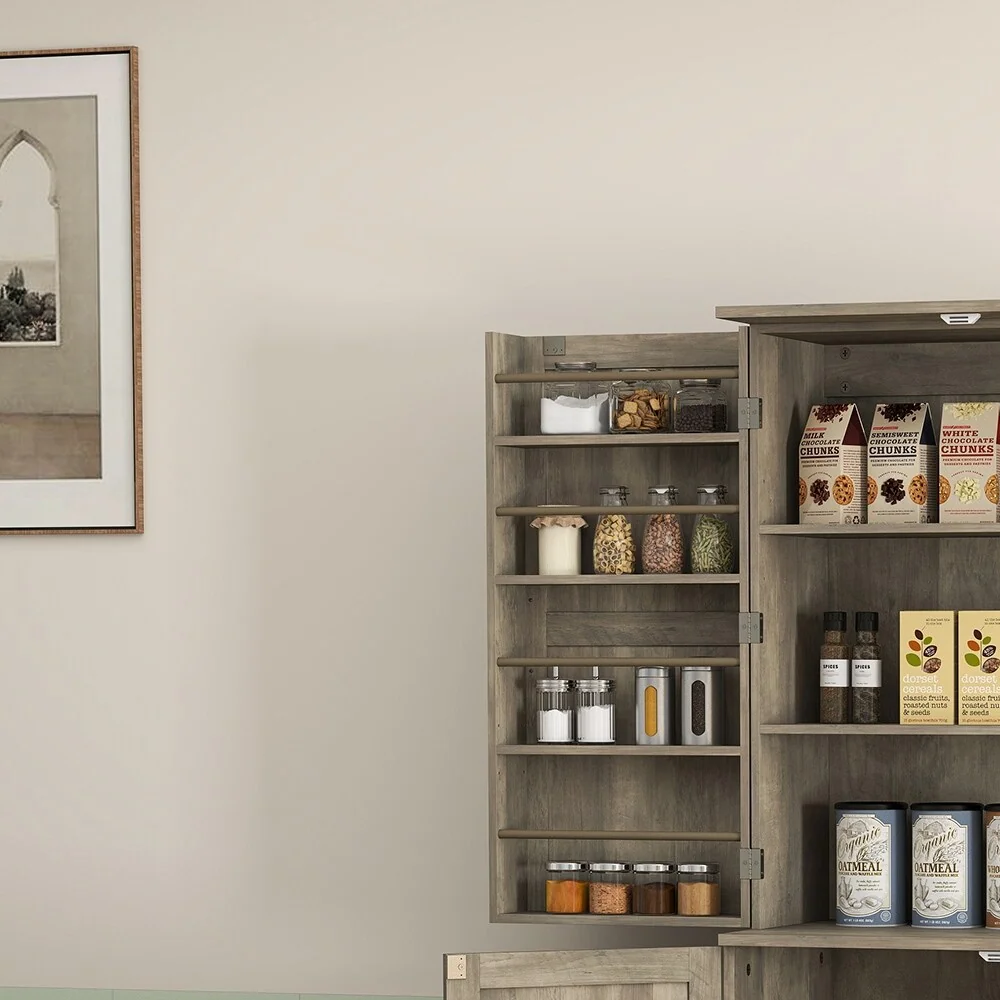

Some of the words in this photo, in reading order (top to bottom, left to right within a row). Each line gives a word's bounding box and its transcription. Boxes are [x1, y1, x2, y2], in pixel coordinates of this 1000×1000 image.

[800, 446, 839, 455] CHUNKS
[869, 446, 917, 454] CHUNKS
[941, 445, 994, 453] CHUNKS
[903, 674, 938, 683] dorset
[962, 674, 997, 683] dorset
[903, 684, 943, 693] cereals
[838, 826, 881, 859] Organic
[914, 827, 958, 860] Organic
[839, 861, 882, 871] OATMEAL
[915, 862, 959, 872] OATMEAL
